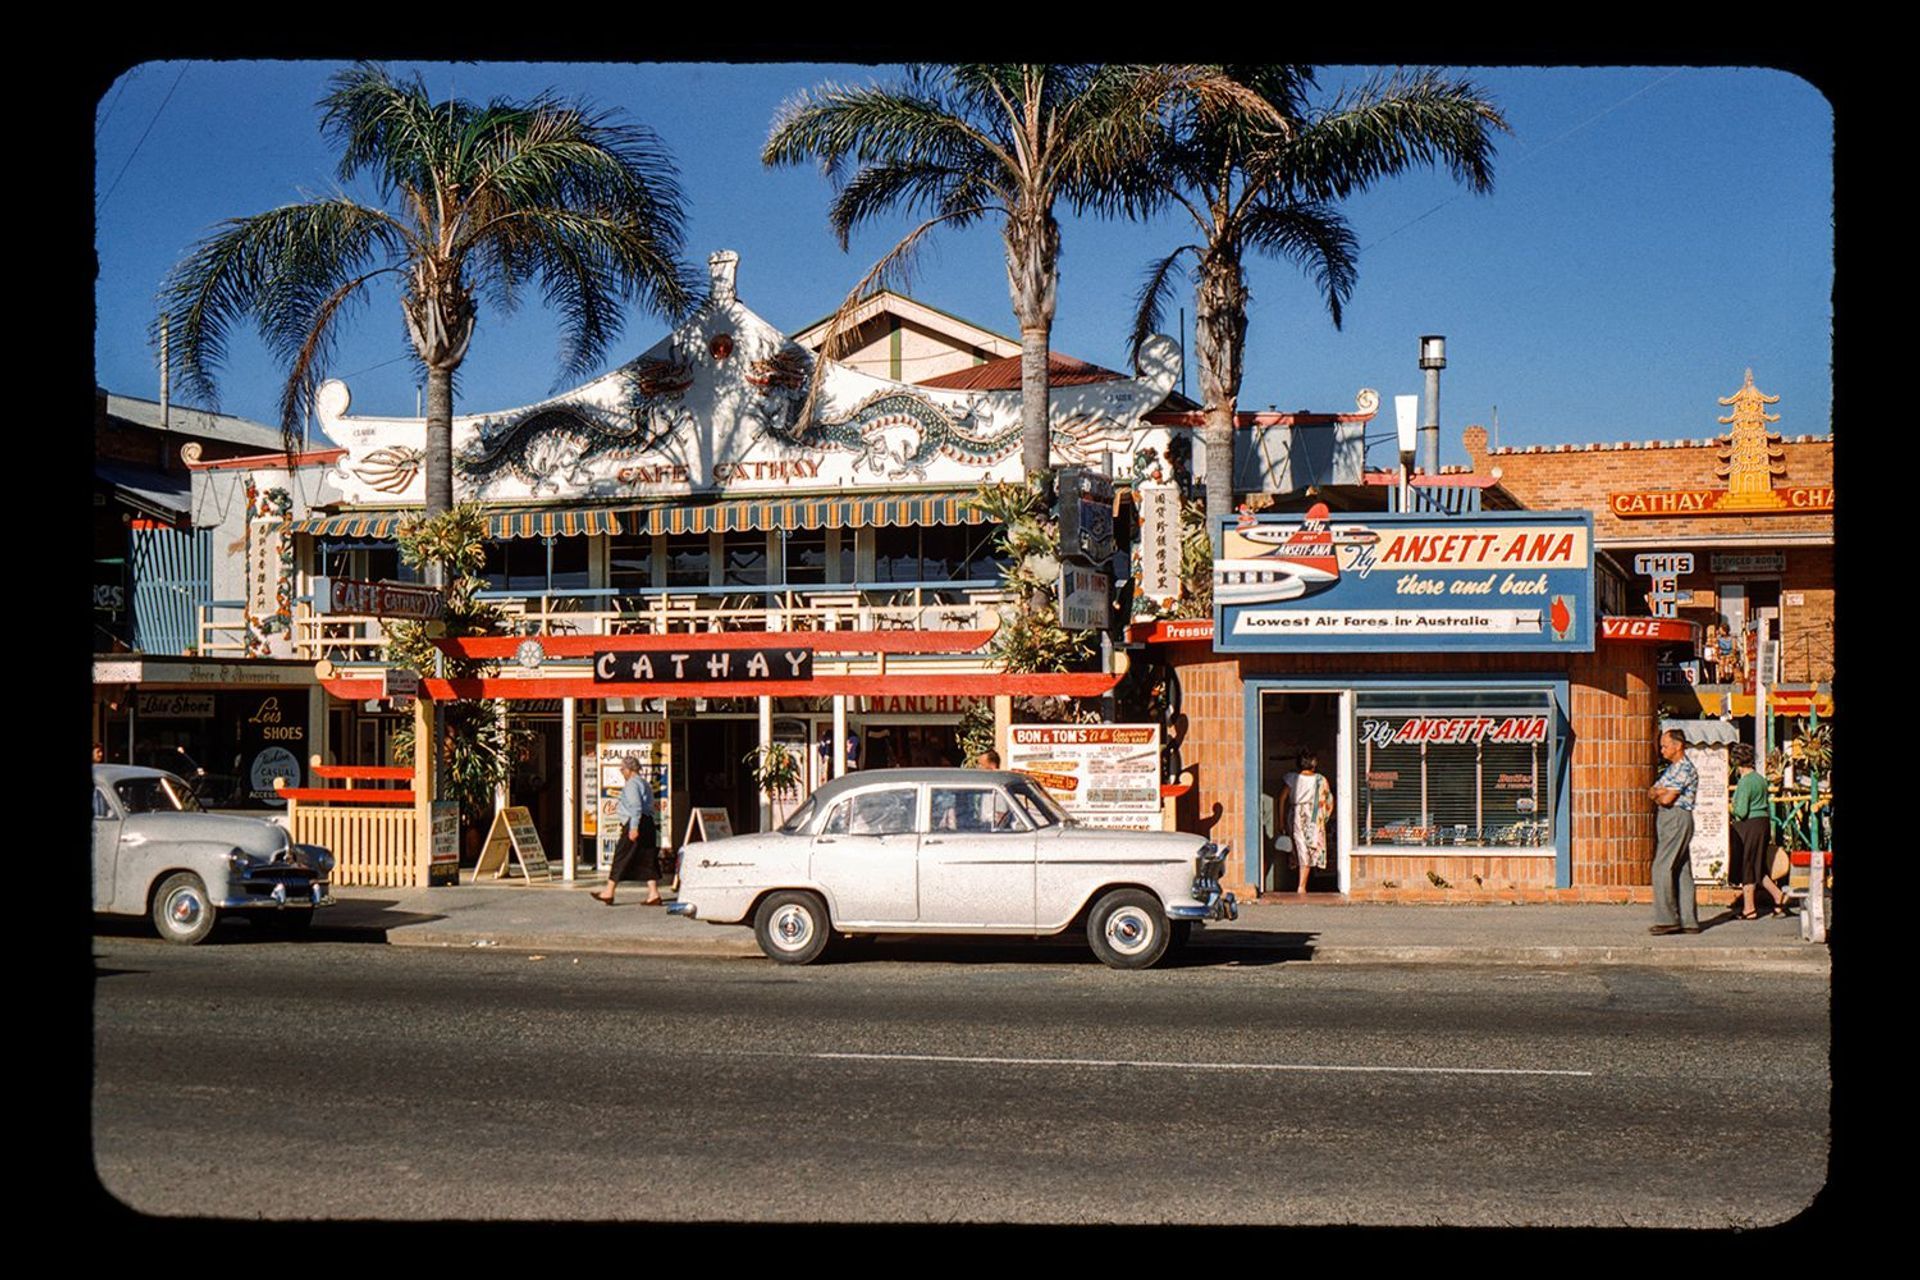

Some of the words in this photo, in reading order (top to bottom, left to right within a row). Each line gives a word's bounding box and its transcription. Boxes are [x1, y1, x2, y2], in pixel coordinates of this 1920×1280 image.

[616, 462, 691, 484] CAFE
[712, 456, 824, 484] CATHAY
[1615, 492, 1709, 512] CATHAY
[1306, 521, 1326, 536] Fly
[1276, 544, 1331, 556] ANSETT-ANA
[1345, 541, 1380, 578] Fly
[1381, 533, 1575, 563] ANSETT-ANA
[1639, 557, 1690, 573] THIS
[1396, 574, 1446, 595] there
[1450, 573, 1492, 596] and
[1499, 573, 1548, 595] back
[1654, 577, 1675, 593] IS
[331, 581, 379, 614] CAFE
[1654, 600, 1675, 615] IT
[1246, 615, 1310, 627] Lowest
[1315, 615, 1339, 626] Air
[1343, 615, 1388, 627] Fares
[1416, 615, 1489, 627] Australia
[1602, 621, 1661, 636] VICE
[597, 651, 808, 680] CATHAY
[248, 696, 282, 724] Lois
[263, 726, 304, 740] SHOES
[1016, 730, 1041, 743] BON
[1042, 733, 1050, 743] &
[1359, 720, 1397, 749] Fly
[1396, 718, 1549, 744] ANSETT-ANA
[600, 749, 623, 762] REAL
